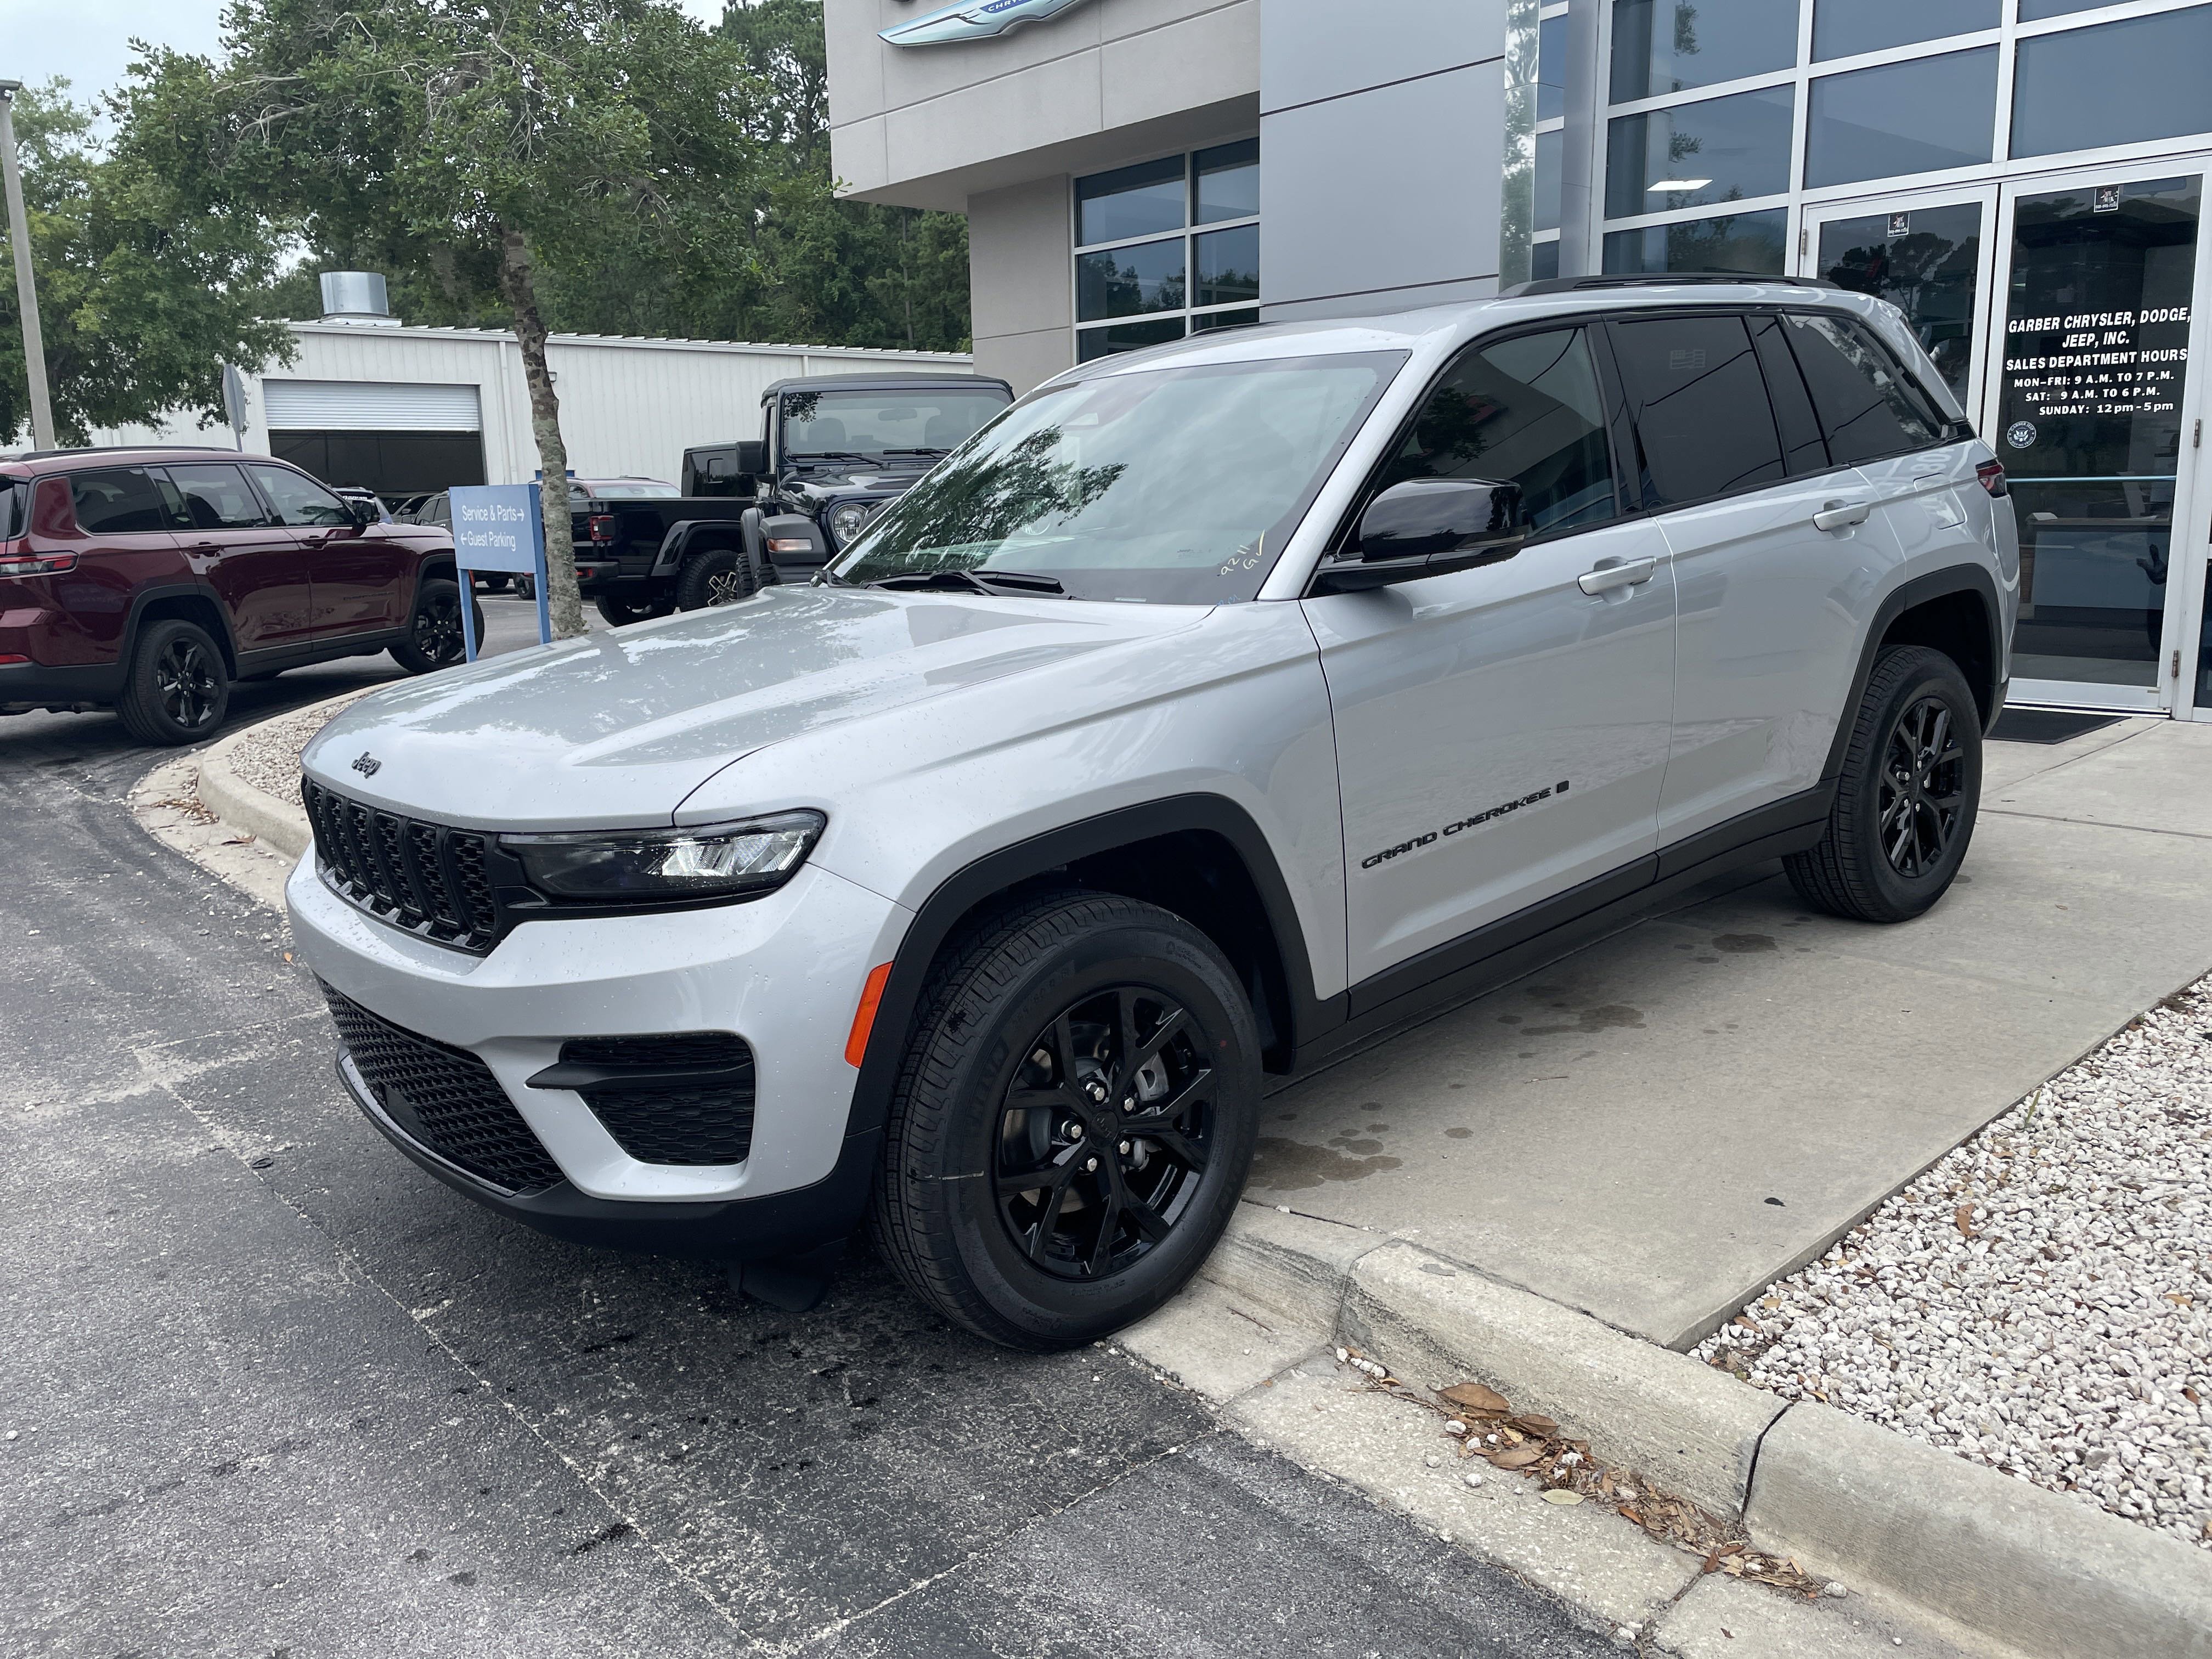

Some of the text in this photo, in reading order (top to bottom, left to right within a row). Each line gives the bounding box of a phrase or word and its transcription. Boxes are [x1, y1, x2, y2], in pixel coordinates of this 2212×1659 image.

[2008, 307, 2190, 332] GARBER CHRYSLER, DODGE,
[2062, 331, 2129, 348] JEEP, INC.
[2006, 348, 2187, 371] SALES DEPARTMENT HOURS
[2075, 376, 2081, 384] 9
[2086, 374, 2112, 383] A.M.
[2117, 373, 2131, 382] TO
[2136, 373, 2143, 381] 7
[2147, 371, 2174, 380] P.M.
[2025, 392, 2050, 402] SAT:
[2072, 390, 2098, 399] A.M.
[2103, 389, 2117, 397] TO
[2133, 387, 2160, 396] P.M.
[2039, 405, 2089, 415] SUNDAY:
[462, 505, 517, 521] Service & Parts
[467, 531, 516, 551] Guest Parking
[351, 751, 382, 779] Jeep
[1362, 787, 1551, 869] GRAND CHEROKEE
